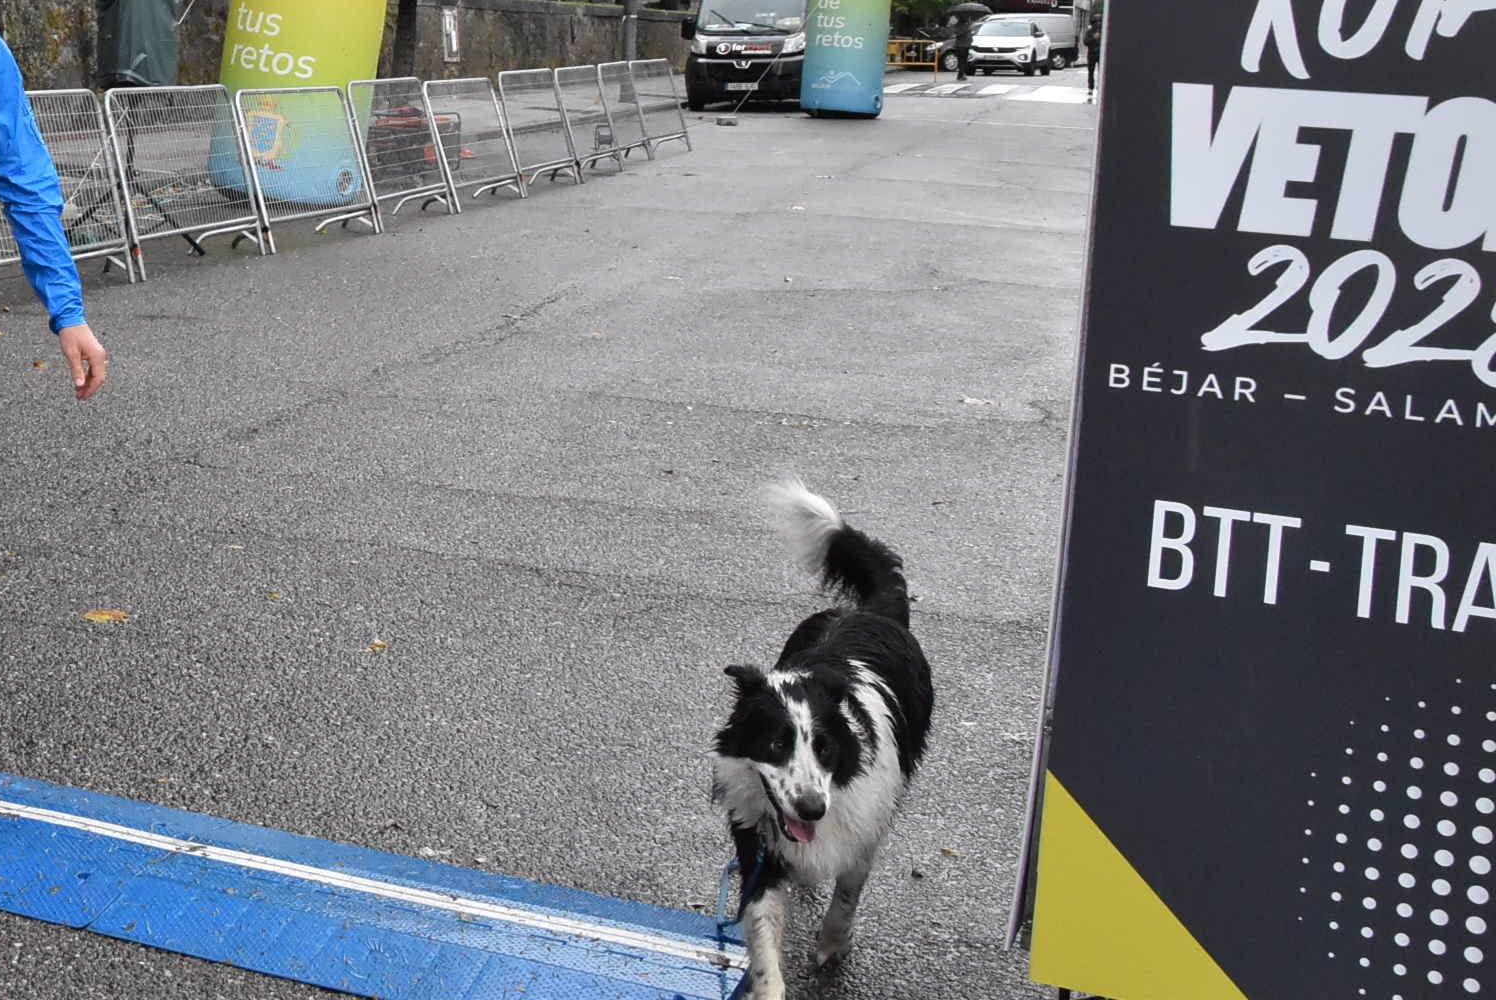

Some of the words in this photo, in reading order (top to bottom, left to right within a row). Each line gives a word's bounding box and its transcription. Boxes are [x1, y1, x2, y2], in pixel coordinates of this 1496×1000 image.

[236, 4, 282, 39] tus
[816, 12, 846, 29] tus
[815, 31, 865, 49] retos
[230, 39, 317, 80] retos
[1170, 81, 1496, 253] VETO
[1108, 361, 1258, 403] BÉJAR
